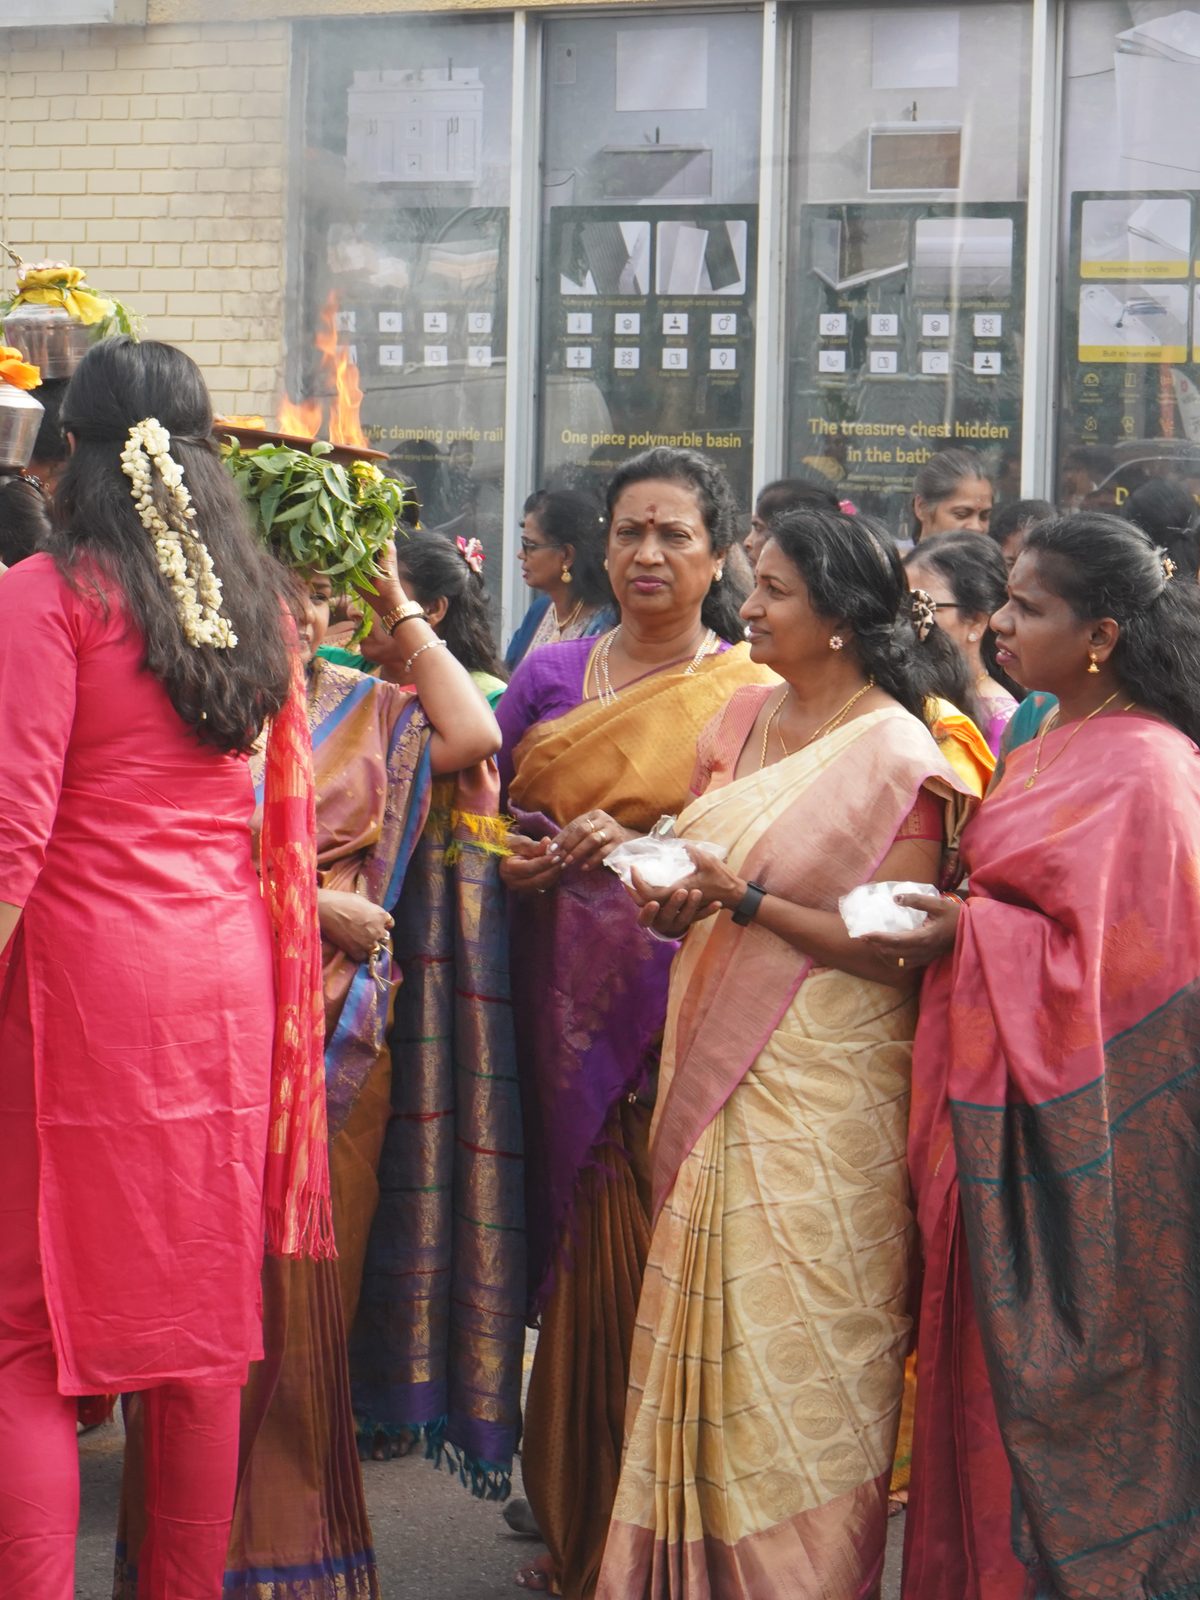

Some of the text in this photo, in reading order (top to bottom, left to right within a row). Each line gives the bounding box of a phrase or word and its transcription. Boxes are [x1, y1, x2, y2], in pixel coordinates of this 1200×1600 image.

[390, 425, 443, 444] damping
[446, 427, 481, 443] guide
[484, 427, 504, 441] rail
[808, 418, 1009, 439] The treasure chest hidden
[561, 429, 741, 449] One piece polymarble basin
[847, 446, 862, 462] in
[866, 447, 892, 463] the
